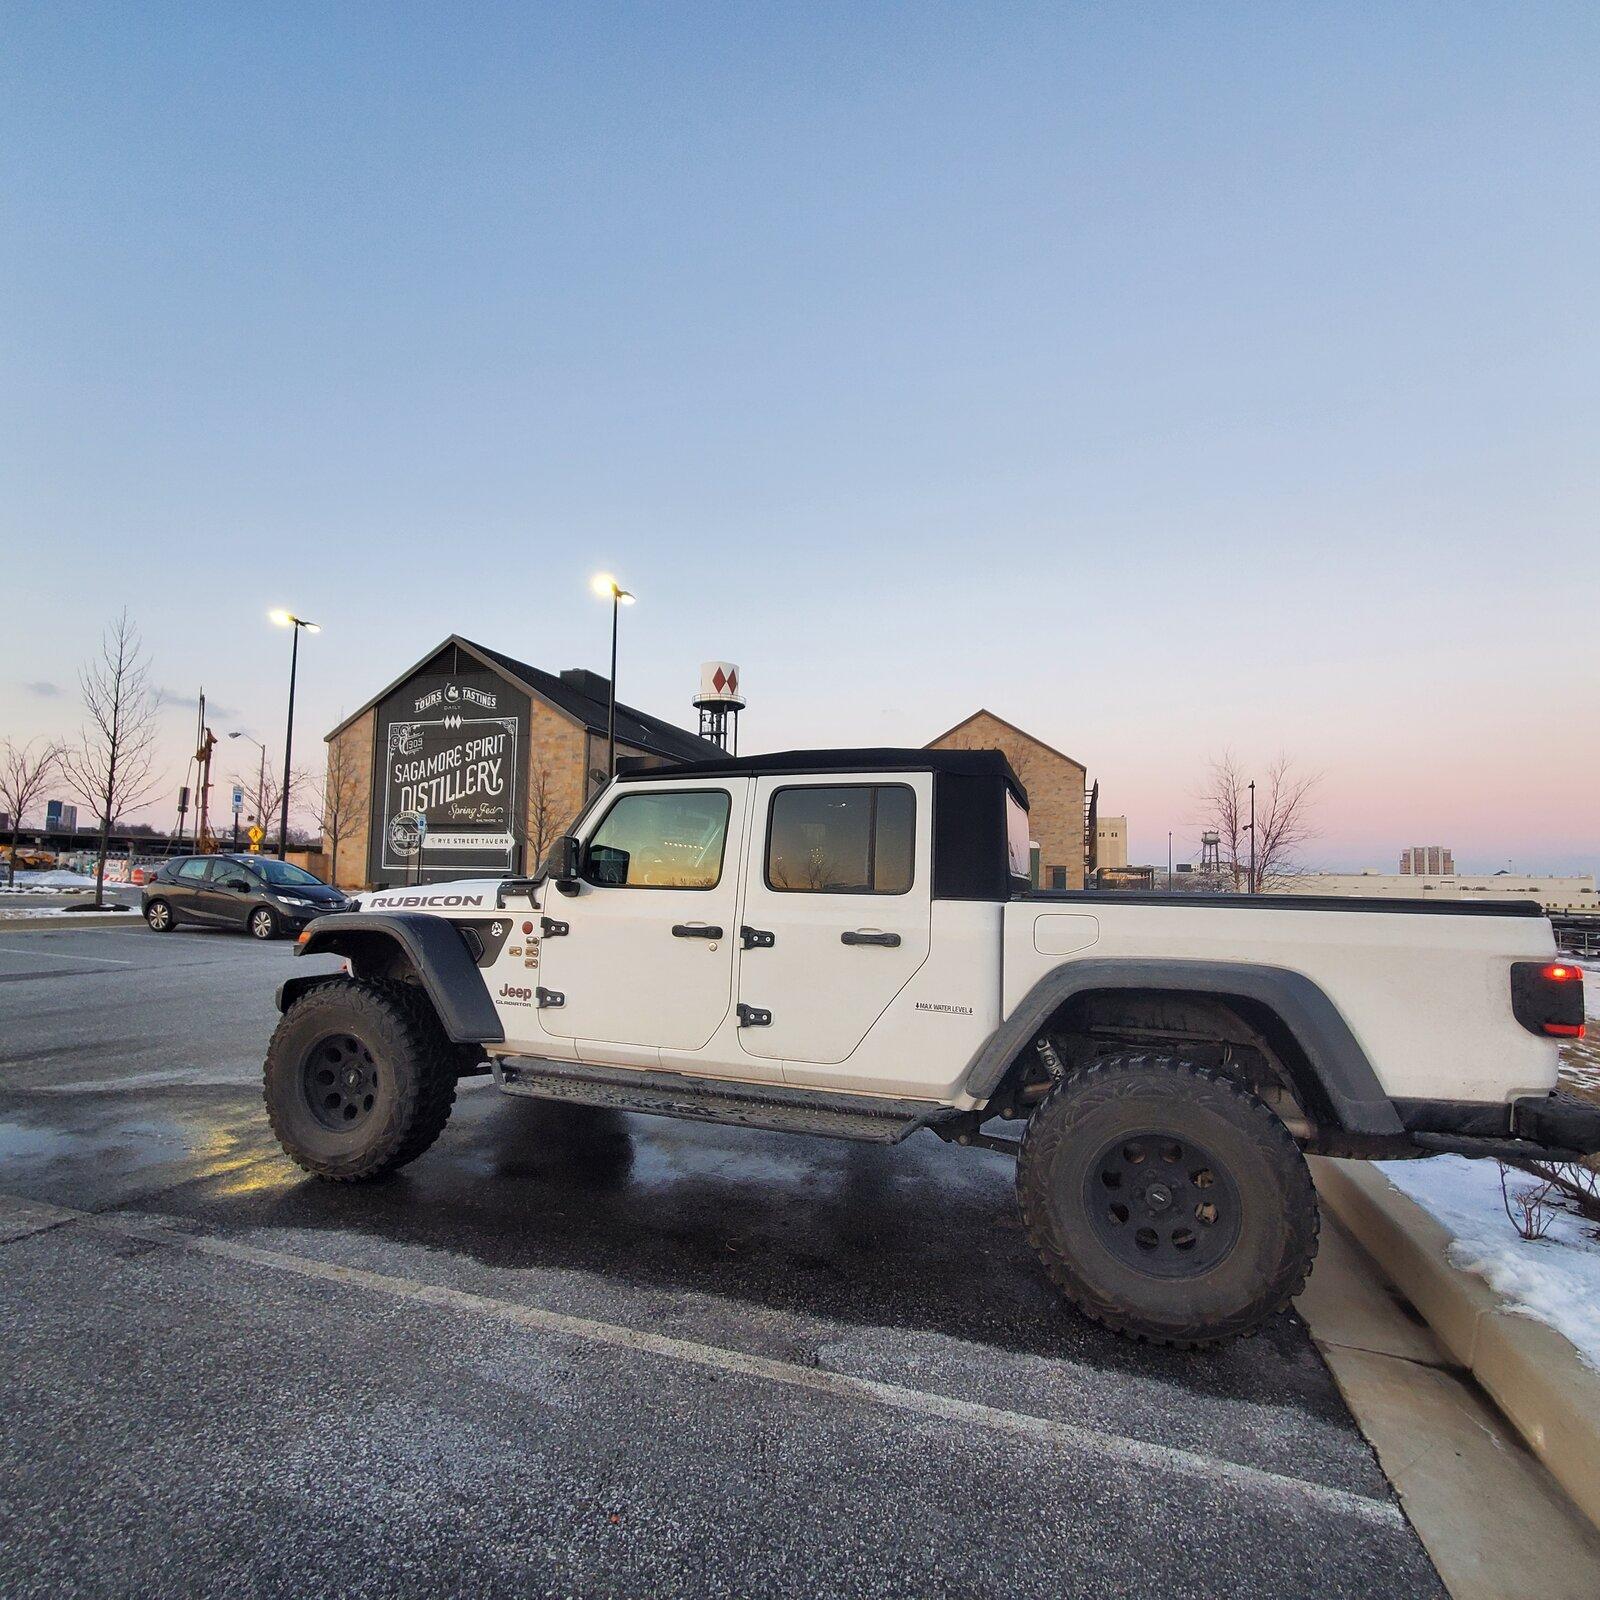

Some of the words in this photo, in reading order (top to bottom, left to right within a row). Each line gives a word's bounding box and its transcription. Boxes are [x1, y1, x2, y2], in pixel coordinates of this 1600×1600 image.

[414, 691, 442, 711] TOURS
[462, 689, 497, 707] TASTINGS
[394, 745, 462, 783] SAGAMORE
[465, 734, 506, 762] SPIRIT
[401, 758, 504, 812] DISTILLERY
[448, 803, 477, 819] Spring
[476, 803, 504, 817] Fed
[370, 895, 484, 907] RUBICON
[499, 983, 532, 1001] Jeep
[495, 999, 532, 1008] GLADIATOR
[919, 1002, 932, 1010] MAX
[933, 1004, 951, 1012] WATER
[952, 1005, 968, 1013] LEVEL
